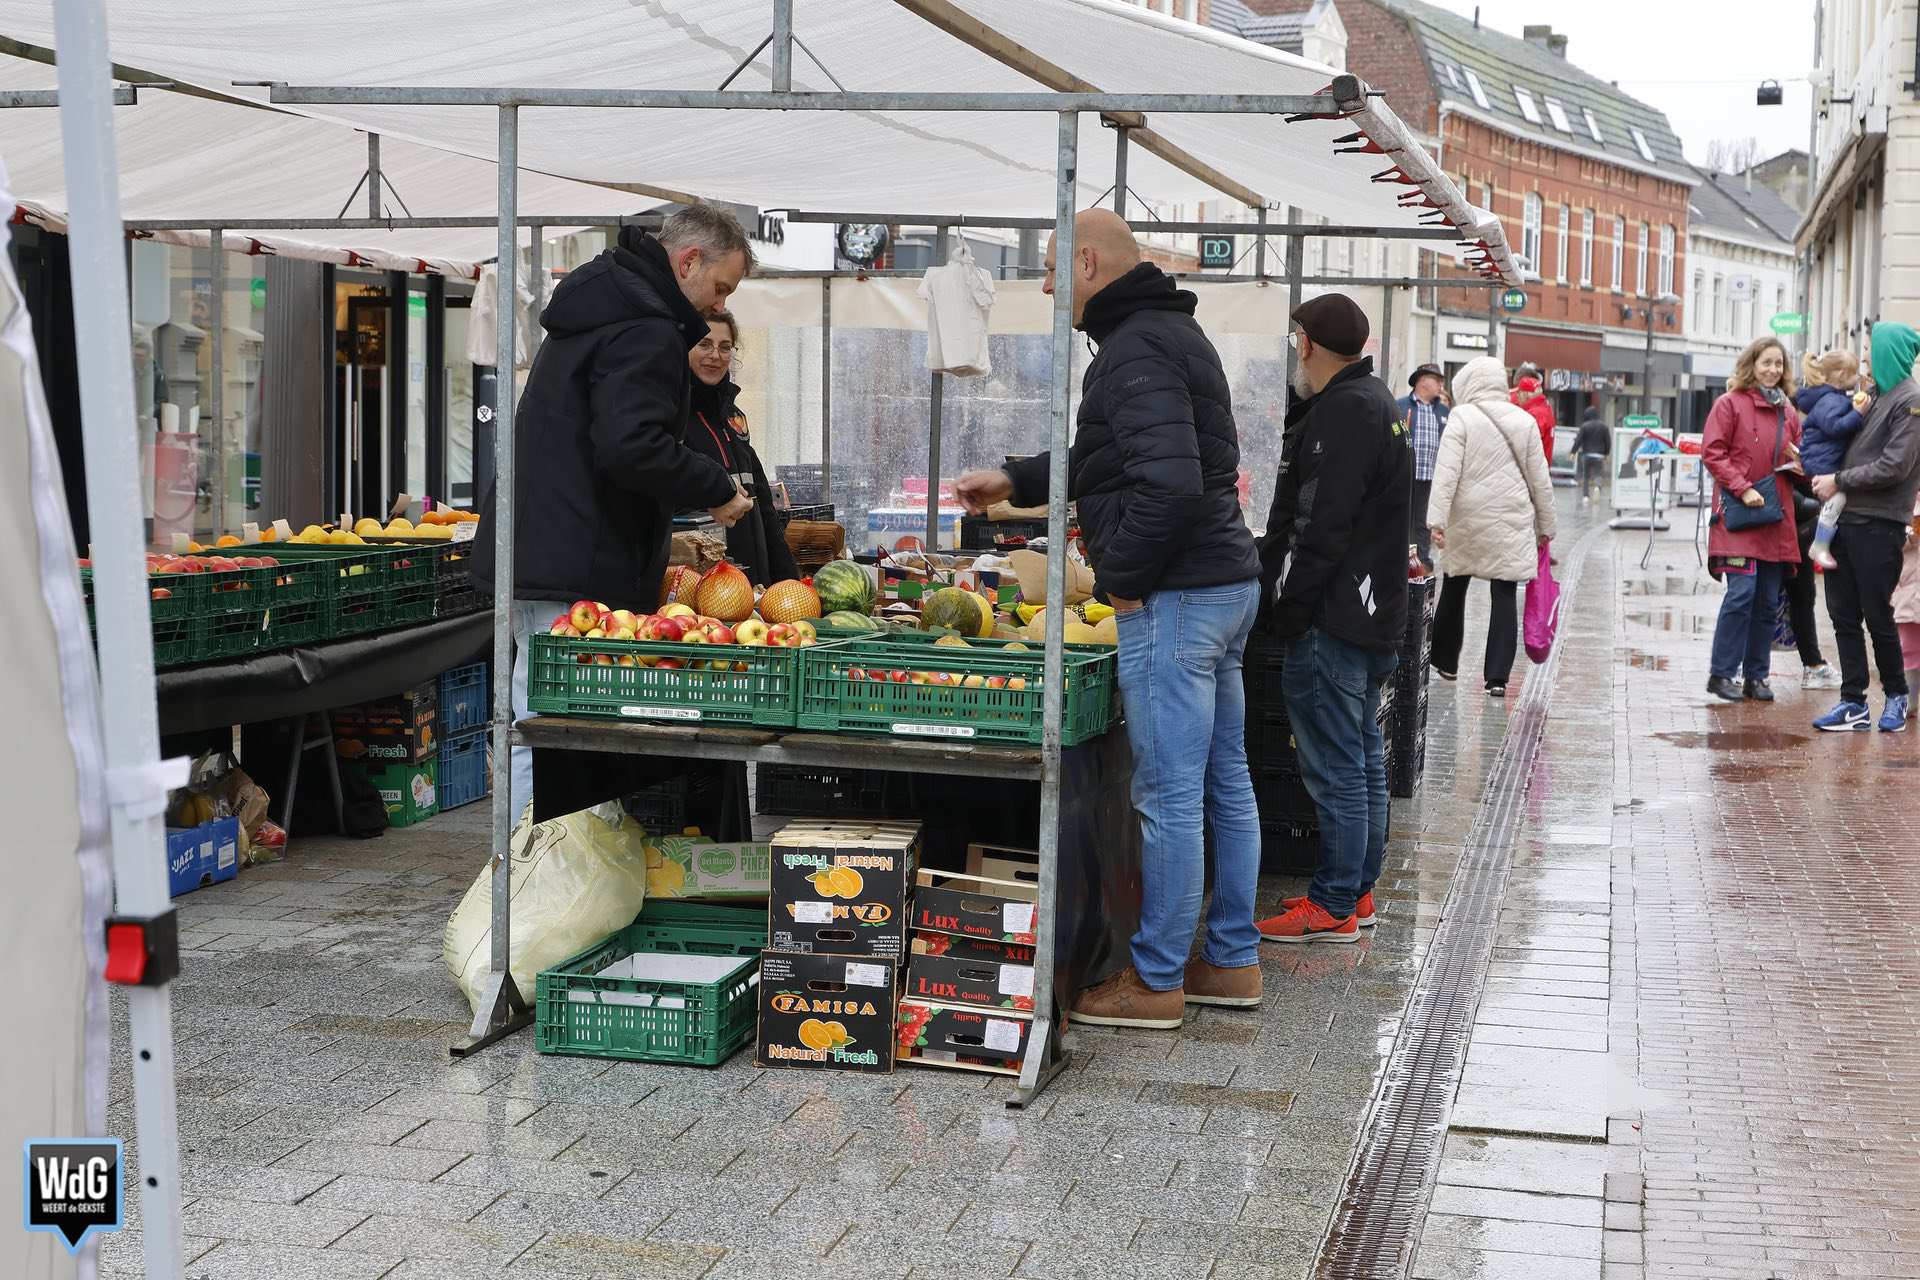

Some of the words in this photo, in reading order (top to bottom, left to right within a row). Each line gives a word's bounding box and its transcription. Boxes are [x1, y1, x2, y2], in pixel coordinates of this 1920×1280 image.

[368, 743, 408, 759] Fresh
[741, 856, 770, 872] PINEA
[783, 853, 828, 871] Fresh
[834, 855, 894, 872] Natural
[785, 903, 884, 920] FAMA
[922, 907, 959, 930] Lux
[963, 923, 993, 937] Quality
[918, 976, 957, 998] Lux
[961, 991, 992, 1002] Quality
[779, 996, 878, 1016] FAMISA
[768, 1044, 828, 1062] Natural
[834, 1047, 879, 1065] Fresh
